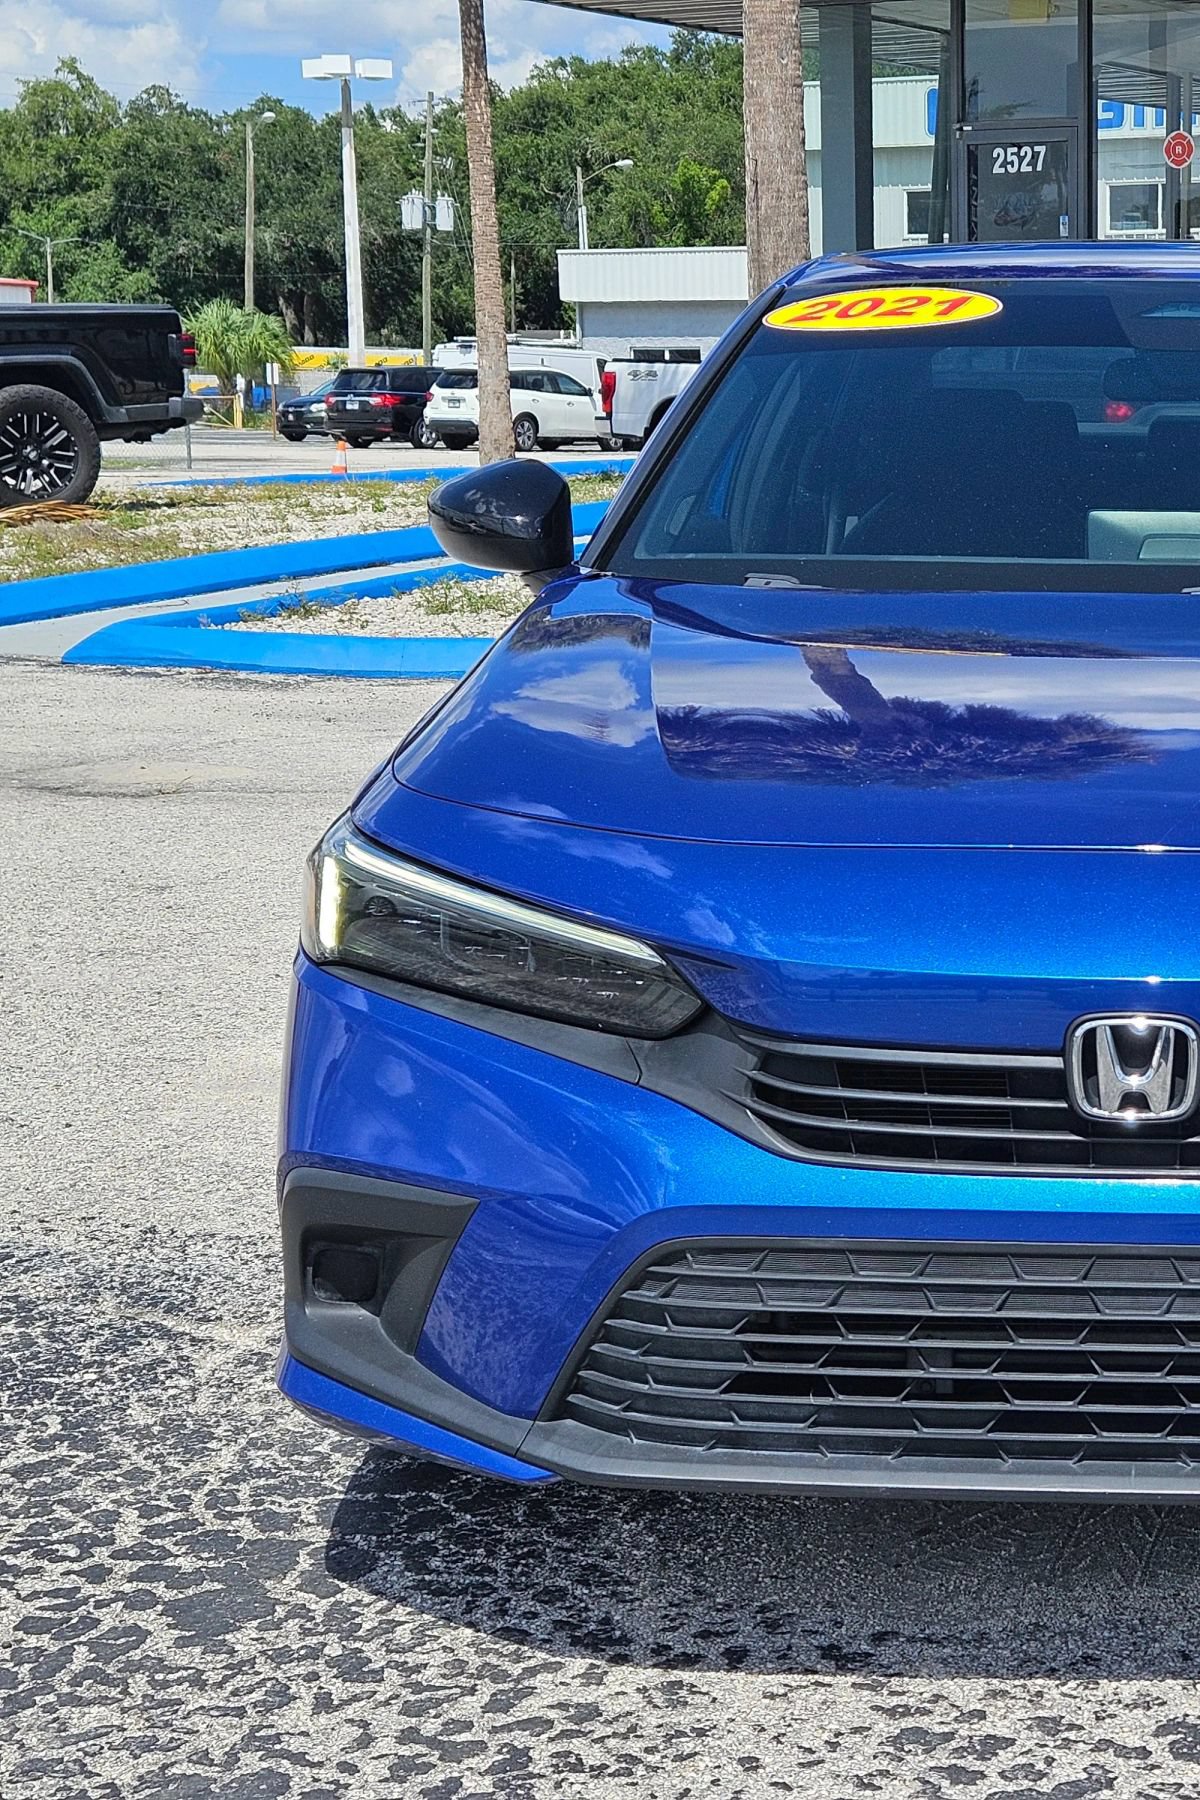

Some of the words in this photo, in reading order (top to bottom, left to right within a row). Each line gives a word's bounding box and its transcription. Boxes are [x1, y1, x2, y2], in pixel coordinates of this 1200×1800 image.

[992, 145, 1047, 174] 2527
[1175, 145, 1183, 155] R
[783, 295, 977, 324] 2021
